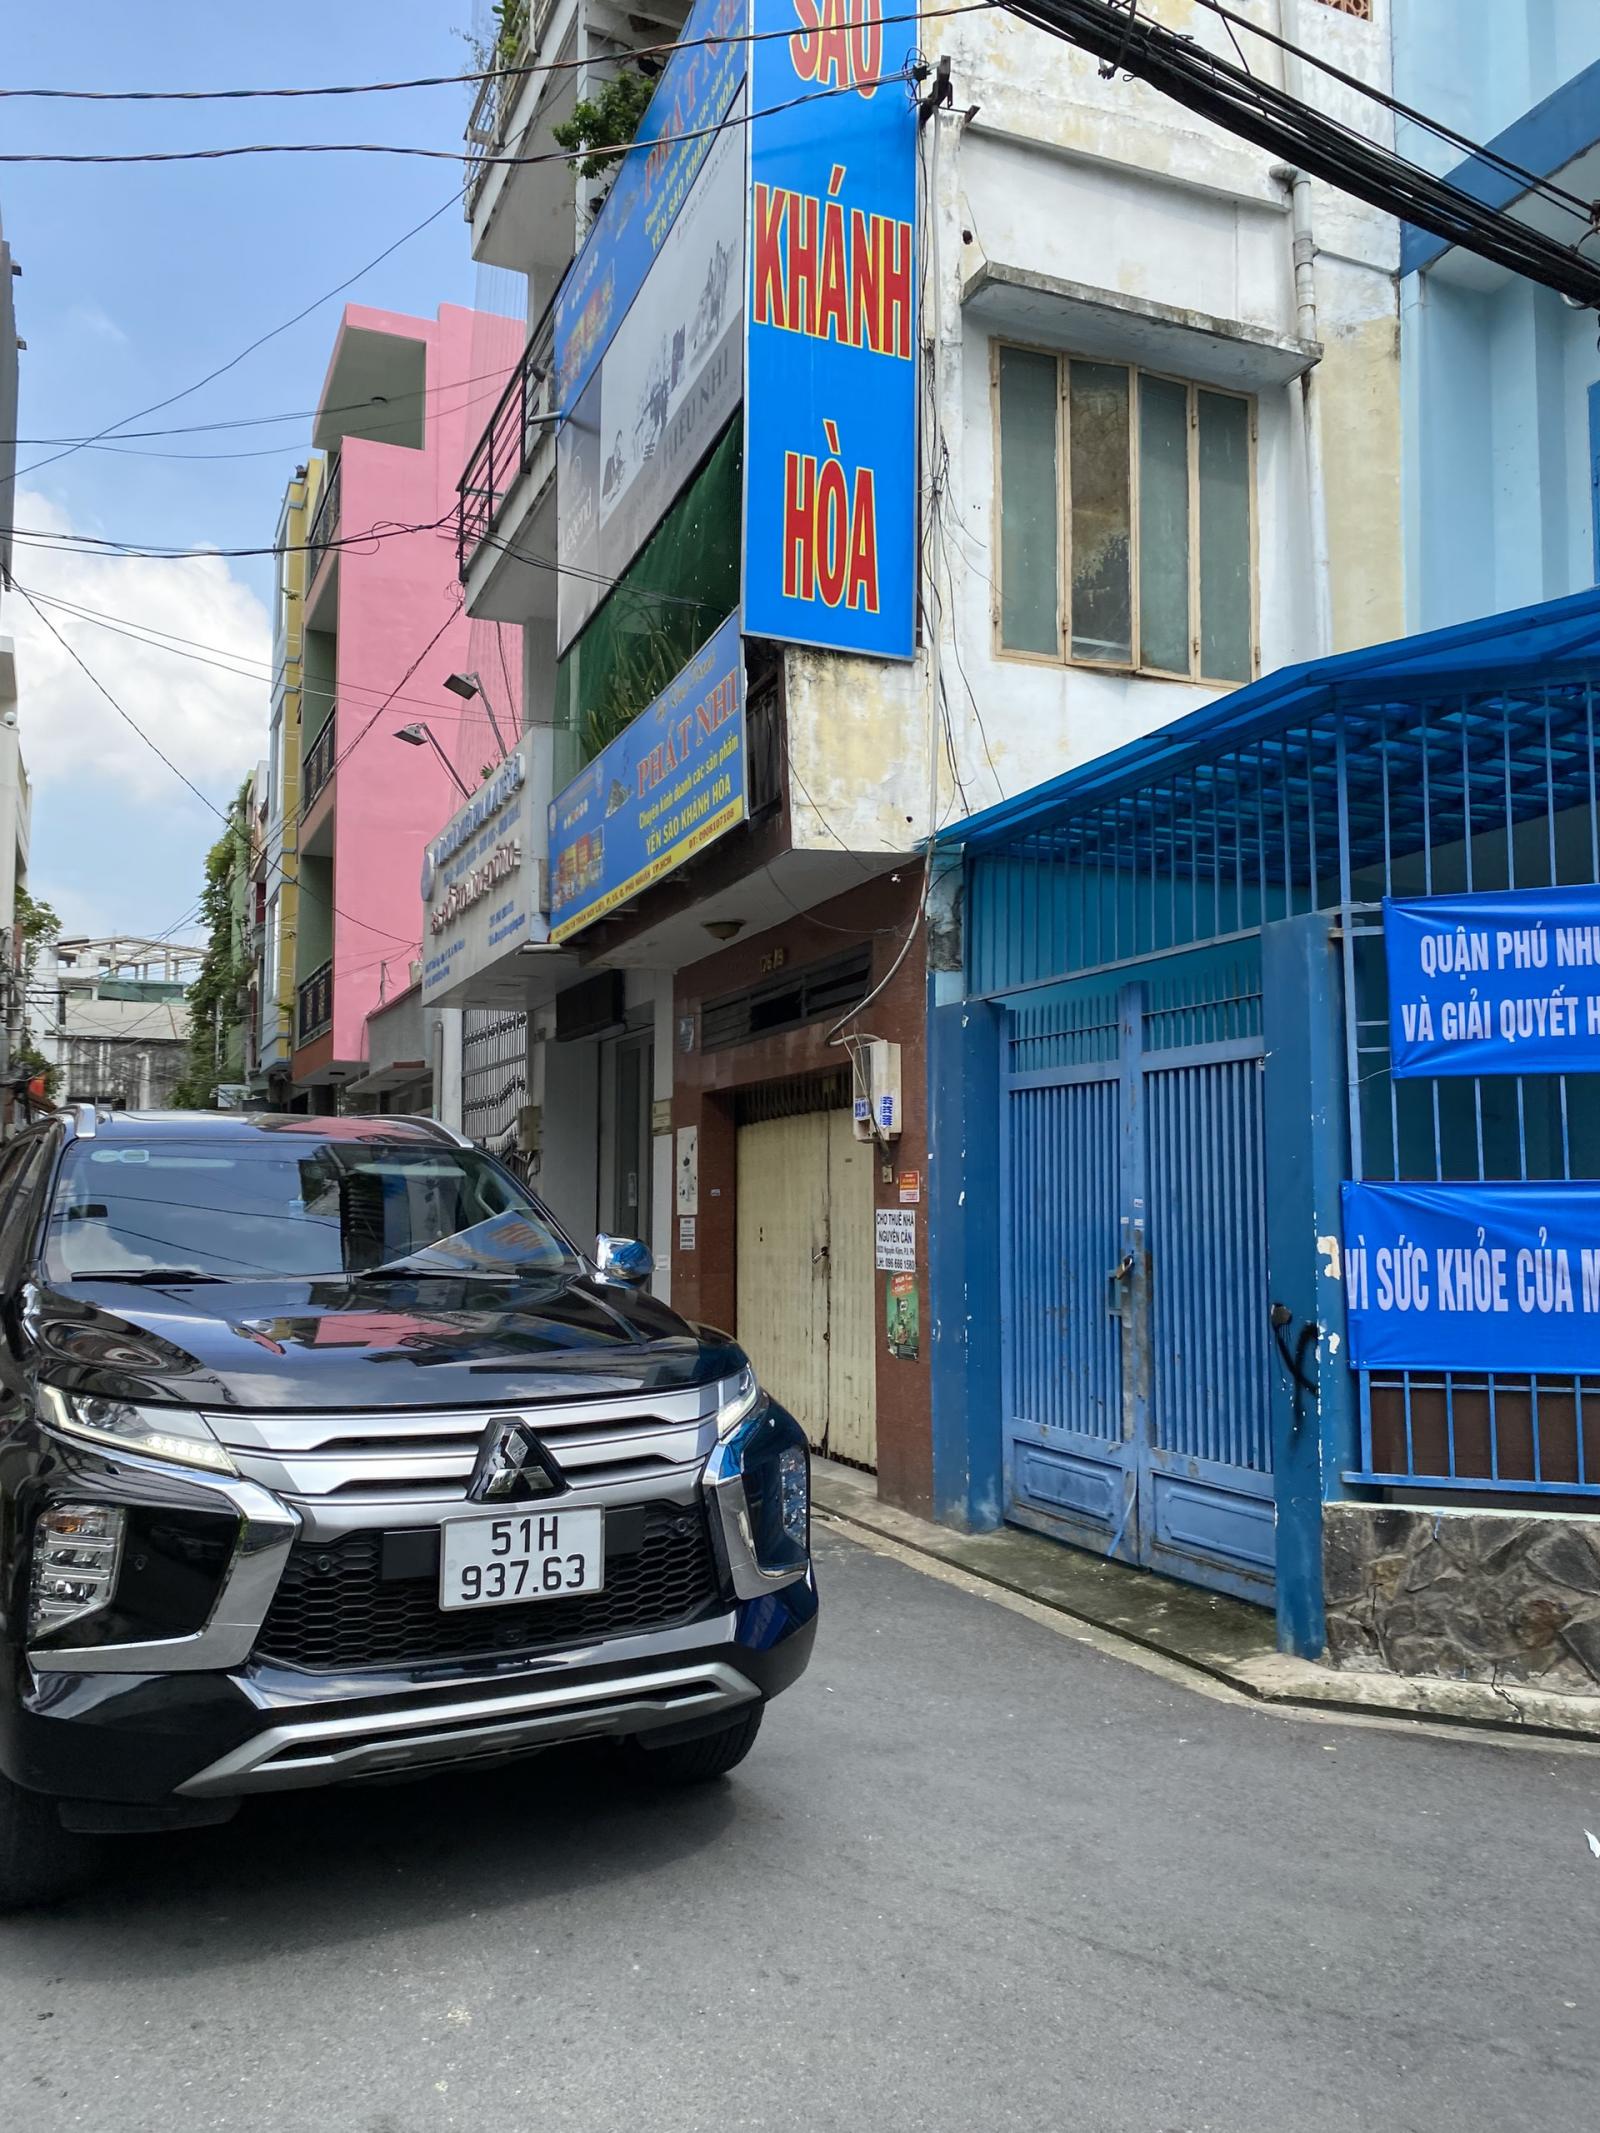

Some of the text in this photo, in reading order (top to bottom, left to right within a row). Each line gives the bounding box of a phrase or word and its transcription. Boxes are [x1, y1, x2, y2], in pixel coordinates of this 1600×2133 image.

[754, 163, 912, 361] KHÁNH
[783, 418, 880, 614] HÒA
[695, 665, 740, 748] NHI
[681, 790, 710, 831] KHÁNH
[712, 773, 731, 807] HÒA
[1420, 925, 1489, 981] QUẬN
[1496, 920, 1549, 970] PHÚ
[1402, 995, 1435, 1042] VÀ
[1441, 988, 1492, 1041] GIẢI
[1500, 985, 1579, 1043] QUYẾT
[1345, 1234, 1369, 1310] VÌ
[1376, 1234, 1429, 1311] SỨC
[1437, 1226, 1509, 1312] KHỎE
[1516, 1226, 1574, 1312] CỦA
[491, 1516, 559, 1556] 51H
[461, 1553, 585, 1601] 937.63
